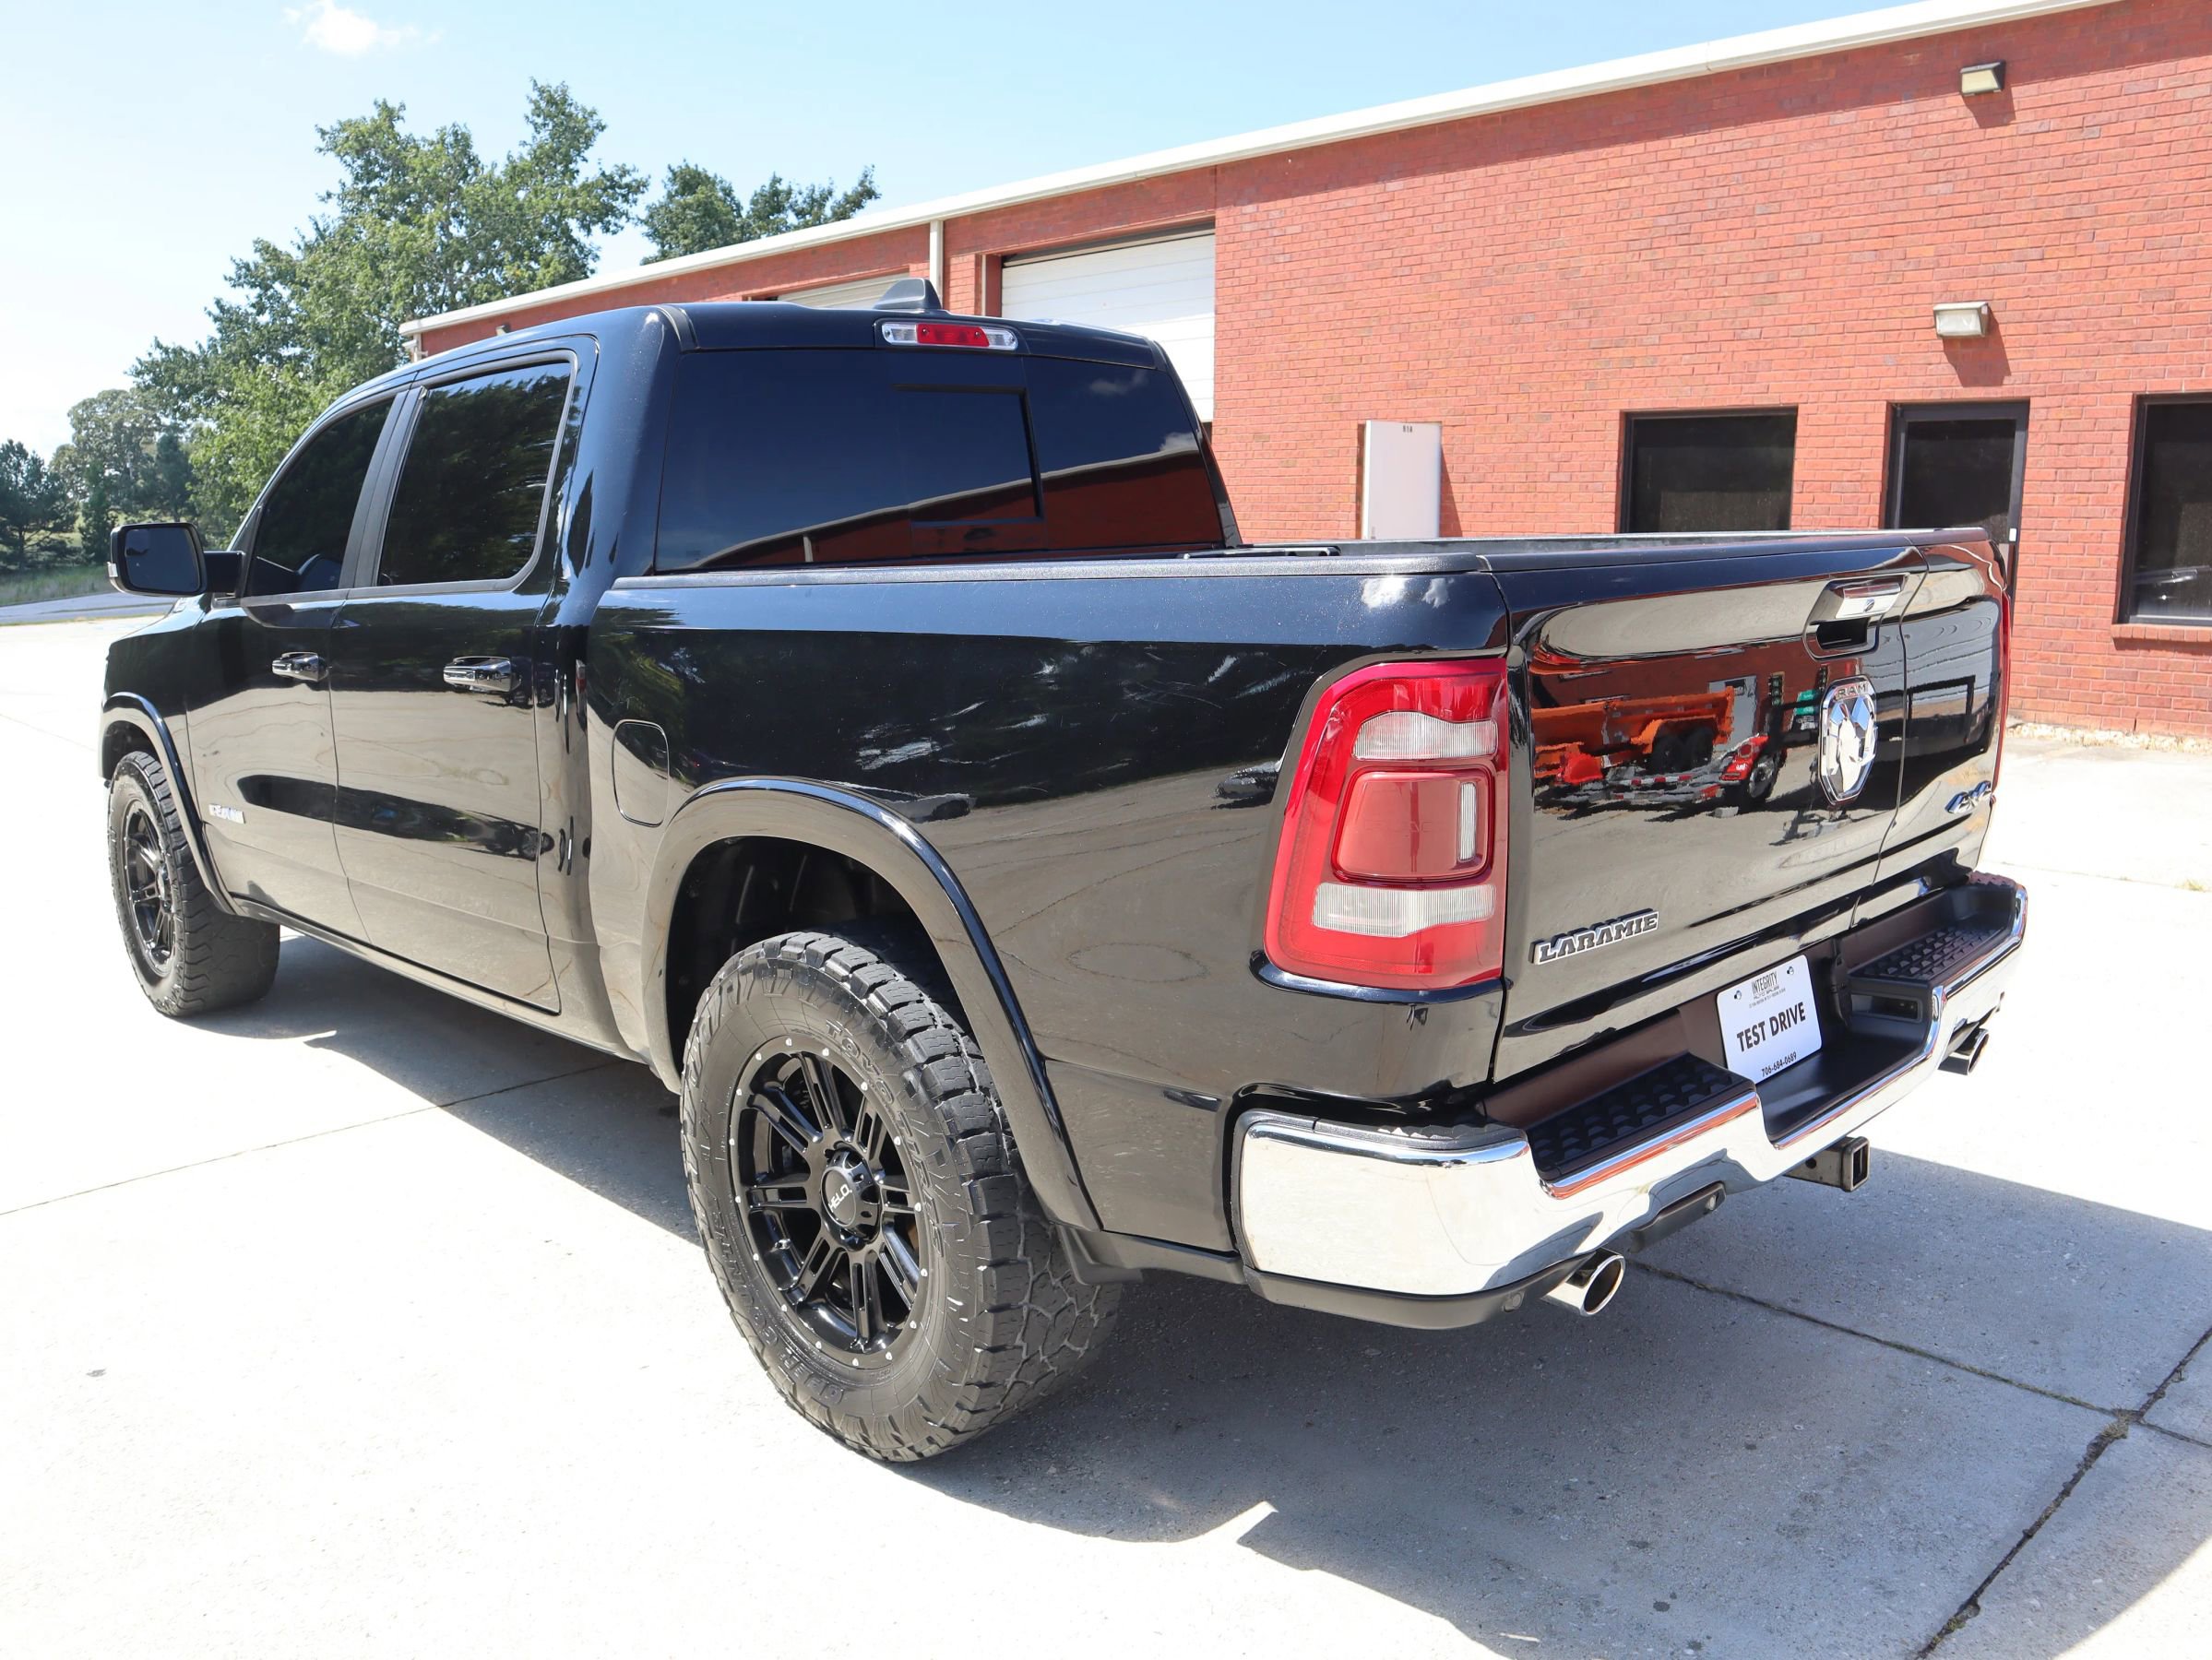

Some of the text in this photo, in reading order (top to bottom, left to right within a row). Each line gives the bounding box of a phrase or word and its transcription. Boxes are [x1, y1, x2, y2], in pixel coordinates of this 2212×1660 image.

[1836, 682, 1867, 699] RAM
[1533, 910, 1659, 965] LARAMIE
[1751, 971, 1778, 995] INTEGRITY
[1736, 1002, 1807, 1052] TEST DRIVE
[1761, 1050, 1797, 1077] 706-684-0689
[826, 1019, 945, 1258] TOYO TIRES
[827, 1183, 853, 1214] HELO
